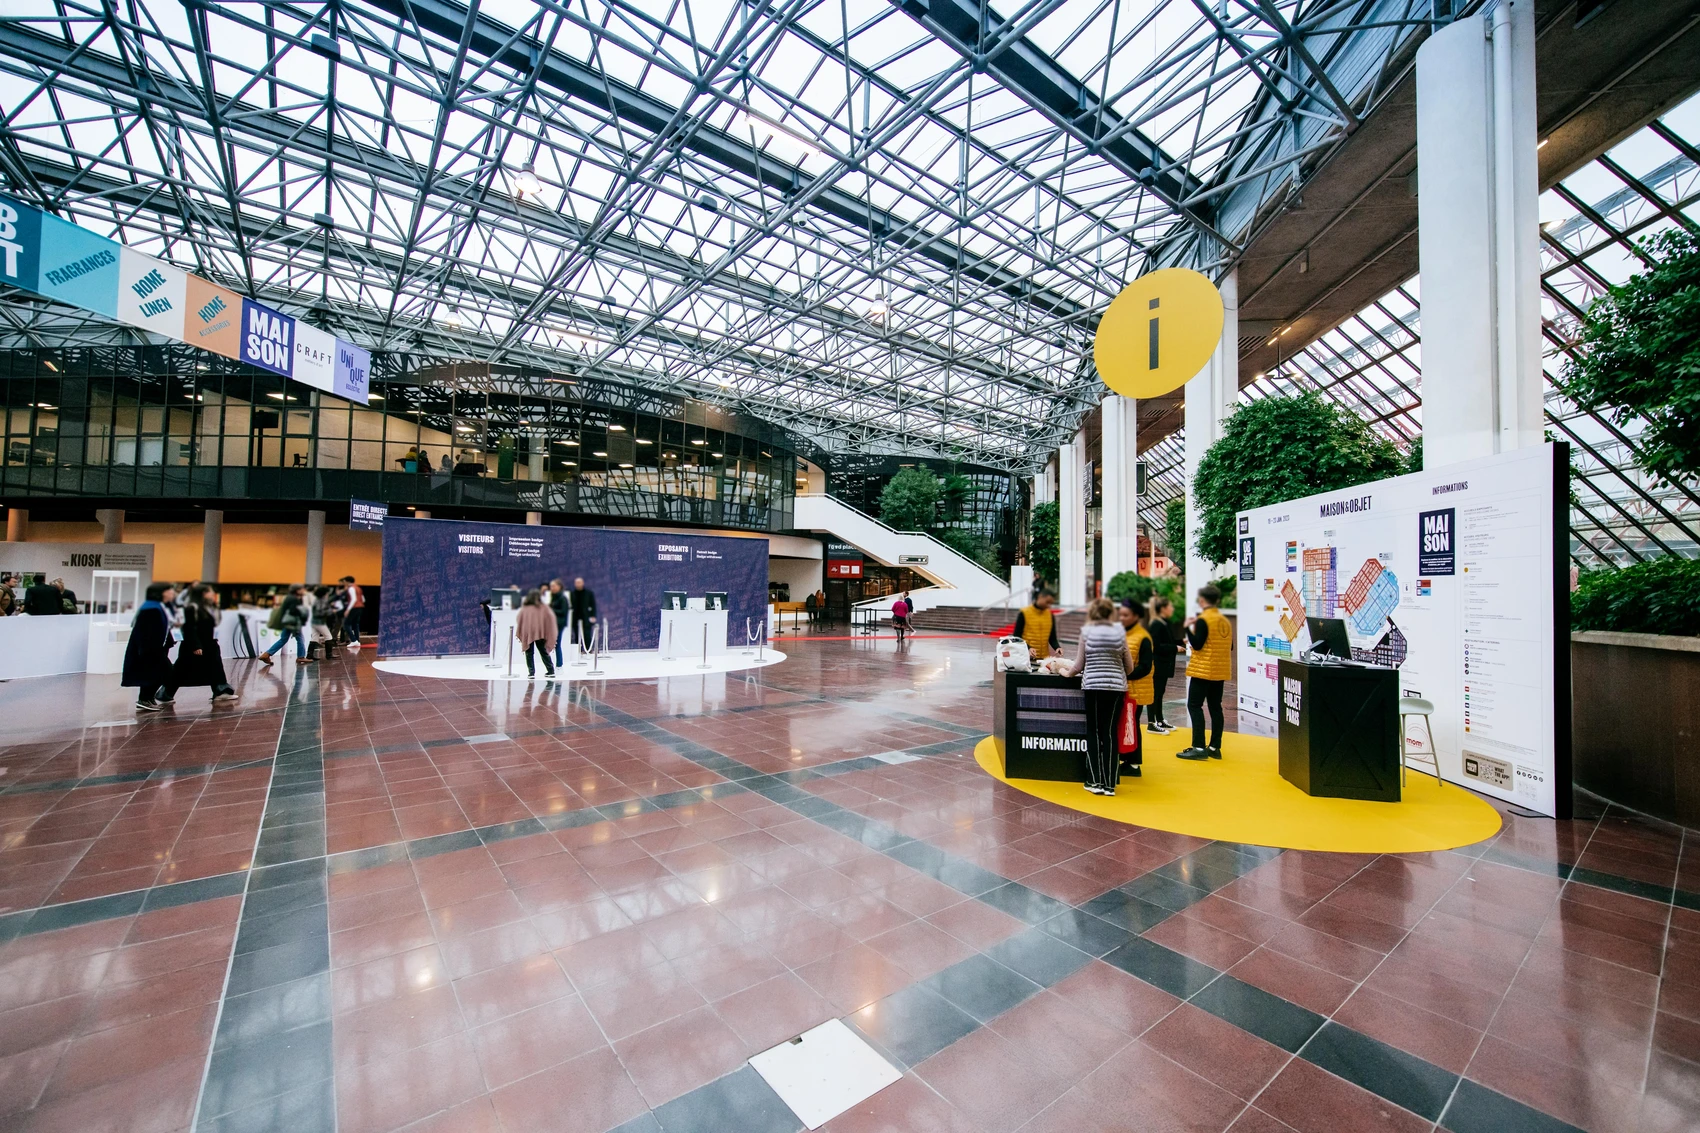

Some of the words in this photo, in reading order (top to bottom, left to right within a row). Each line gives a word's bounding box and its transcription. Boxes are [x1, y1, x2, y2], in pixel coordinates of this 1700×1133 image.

[44, 249, 116, 286] FRAGRANCES
[132, 268, 167, 299] HOME
[139, 297, 173, 318] LINEN
[198, 295, 227, 323] HOME
[199, 319, 231, 337] ACCESSORIES
[249, 307, 289, 346] MAI
[1149, 297, 1160, 371] i
[247, 334, 288, 371] SON
[297, 343, 332, 364] CRAFT
[350, 368, 364, 384] QUE
[346, 383, 360, 394] ECLECTIC
[1432, 481, 1468, 495] INFORMATIONS
[353, 504, 370, 512] ENTRÉE
[370, 506, 388, 515] DIRECTE
[353, 511, 366, 519] DIRECT
[366, 513, 384, 521] ENTRANCE
[1320, 496, 1372, 518] MAISON&OBJET
[1424, 514, 1449, 534] MAI
[458, 534, 495, 543] VISITEURS
[1424, 533, 1449, 552] SON
[458, 546, 484, 554] VISITORS
[1242, 552, 1252, 565] JET
[70, 554, 102, 567] KIOSK
[1283, 676, 1302, 696] MAISON
[1286, 707, 1300, 727] PARIS
[1021, 736, 1088, 752] INFORMATIO
[1406, 737, 1422, 747] mom
